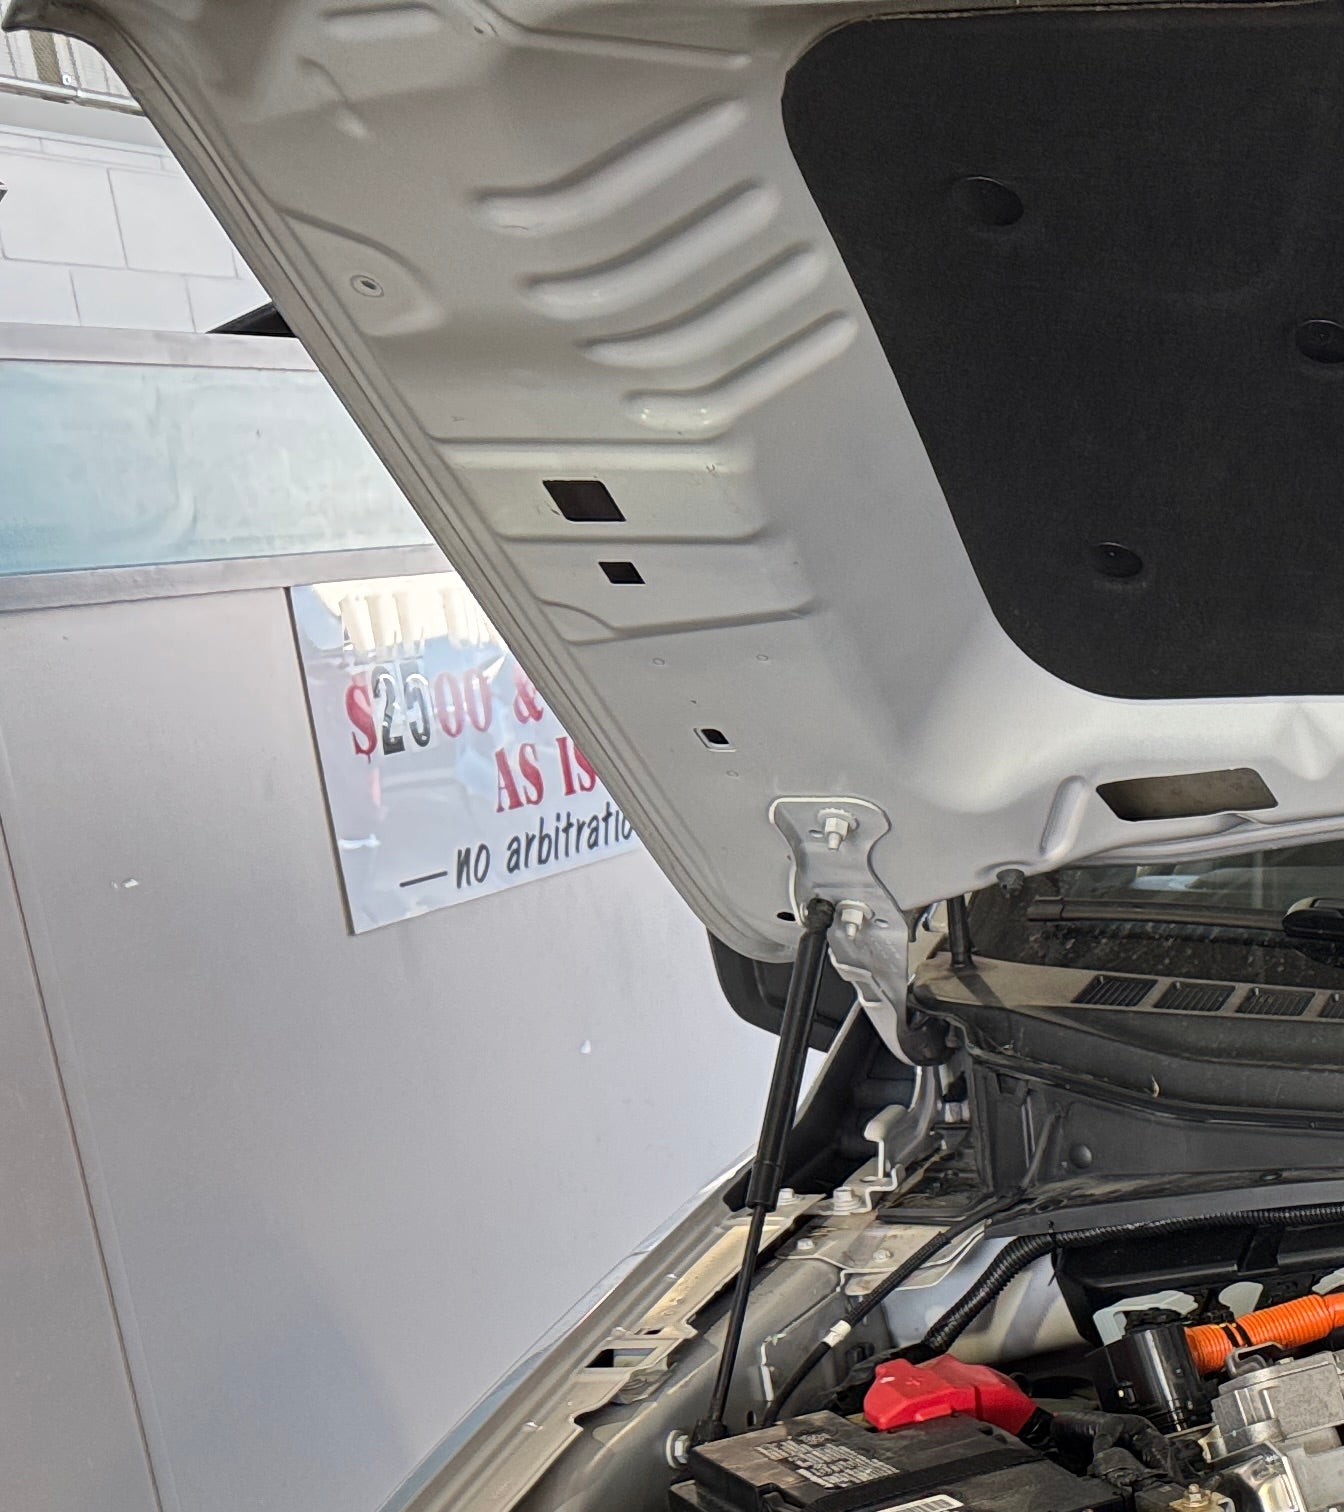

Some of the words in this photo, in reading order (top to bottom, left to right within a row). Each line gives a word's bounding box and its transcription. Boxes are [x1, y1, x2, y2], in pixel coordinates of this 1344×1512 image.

[345, 662, 493, 764] $2500
[495, 742, 545, 813] AS
[555, 736, 597, 797] IS
